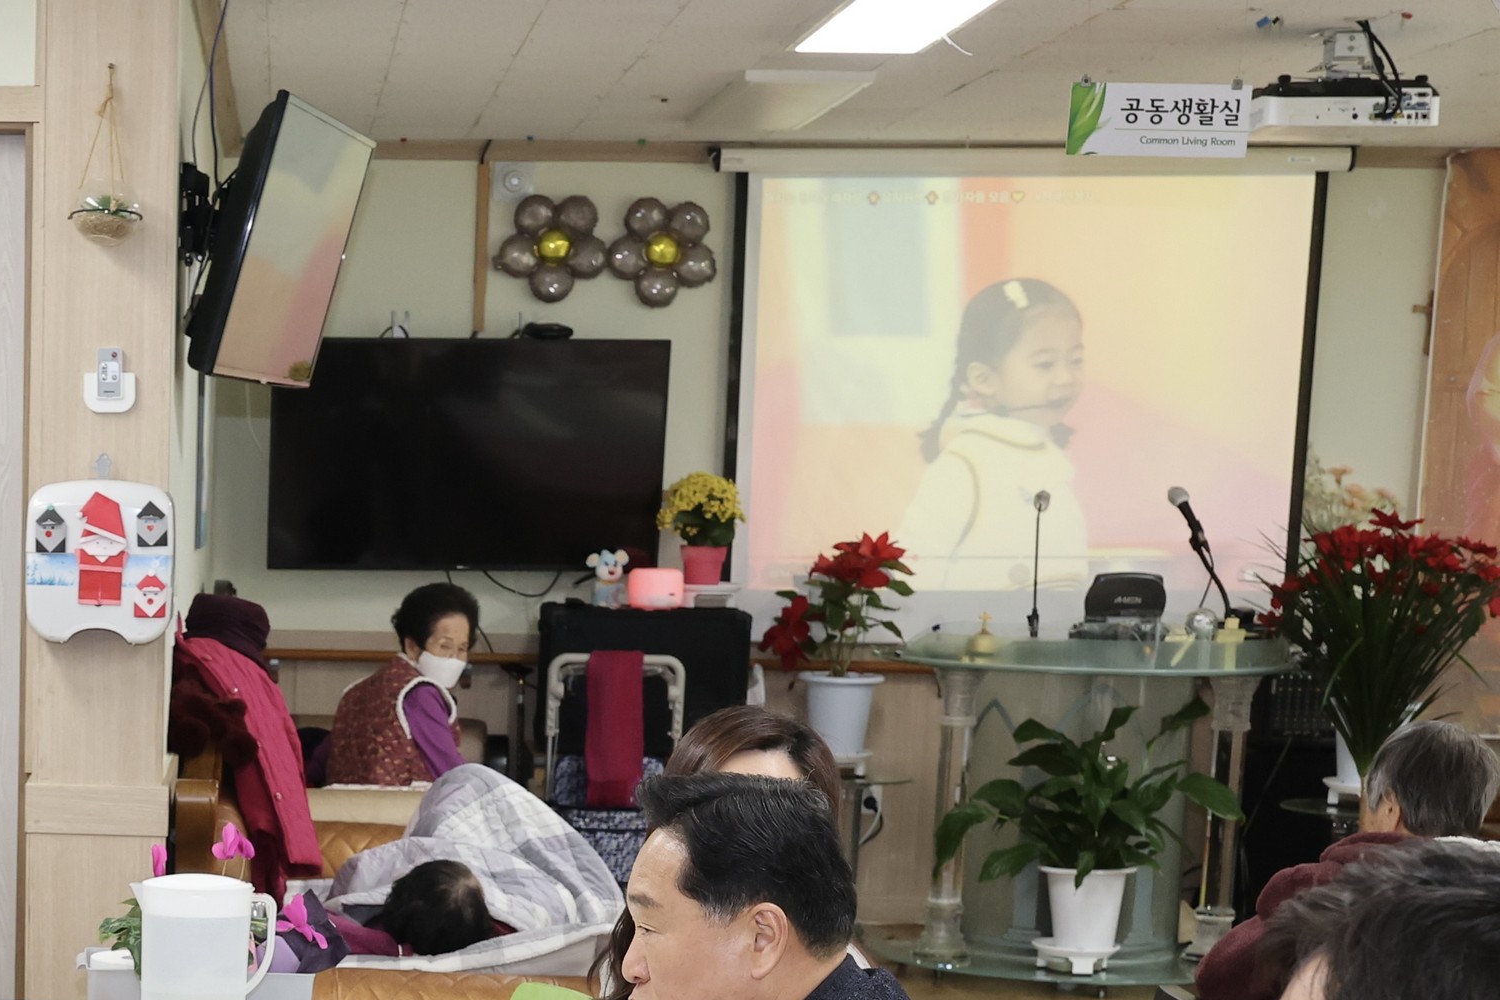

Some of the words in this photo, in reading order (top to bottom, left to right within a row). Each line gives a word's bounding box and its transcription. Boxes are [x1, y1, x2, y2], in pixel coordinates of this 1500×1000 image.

[1120, 98, 1241, 126] 공동생활실
[1140, 135, 1179, 146] Common
[1181, 136, 1208, 147] Living
[1210, 137, 1236, 147] Room
